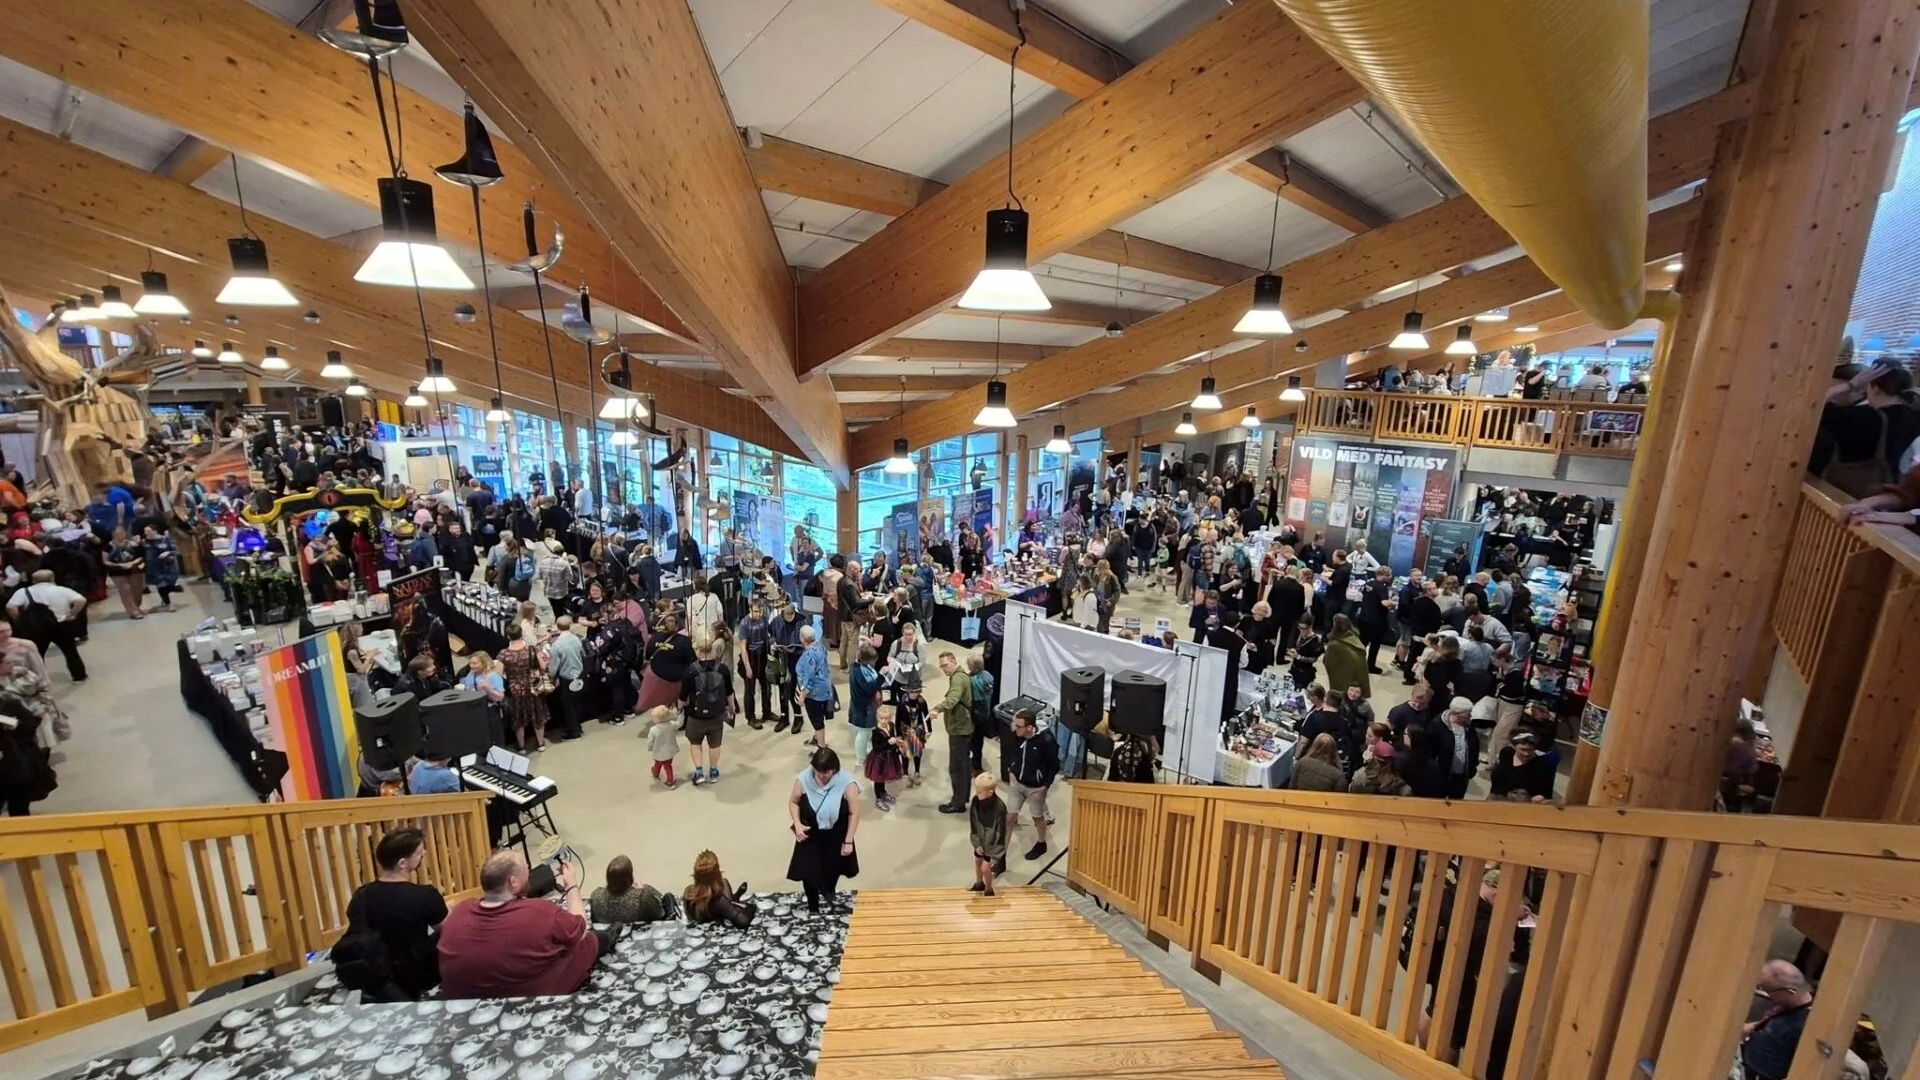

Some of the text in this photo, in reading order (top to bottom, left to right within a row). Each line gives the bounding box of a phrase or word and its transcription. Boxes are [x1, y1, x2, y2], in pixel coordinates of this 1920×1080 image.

[1299, 445, 1332, 460] VILD
[1336, 449, 1371, 464] MED
[1374, 453, 1449, 471] FANTASY
